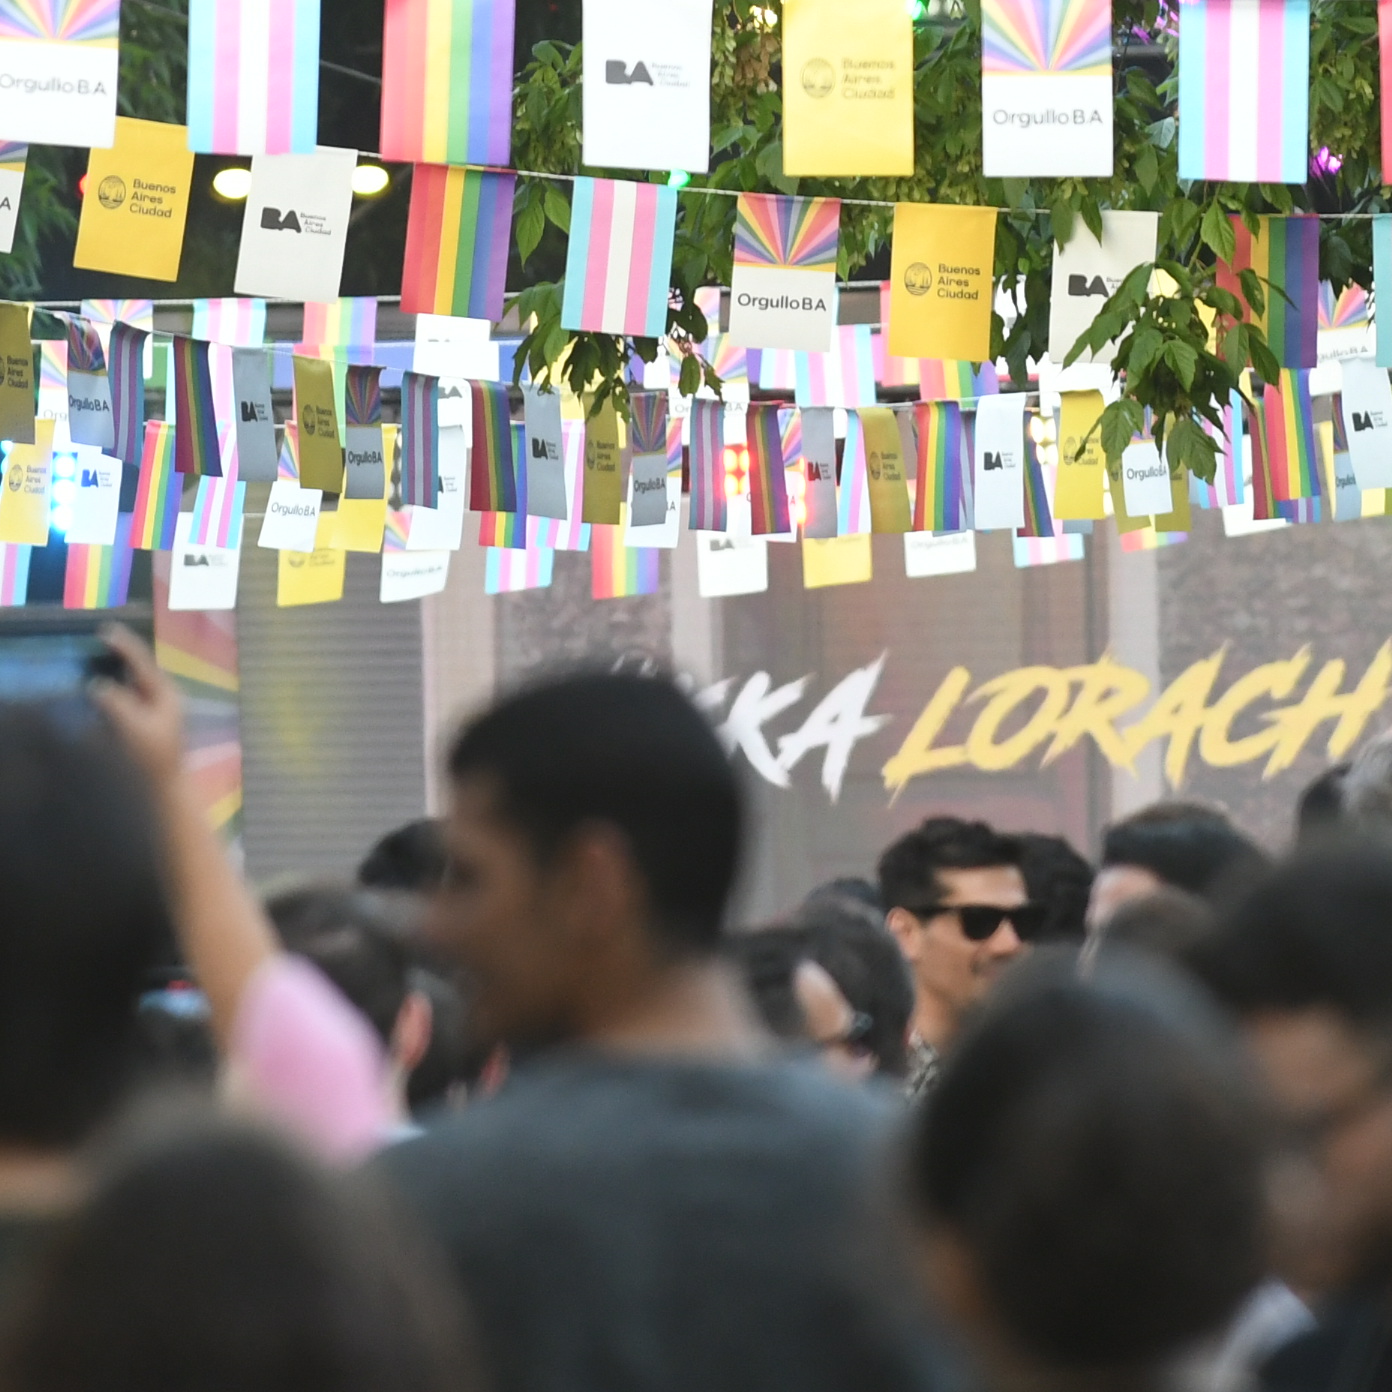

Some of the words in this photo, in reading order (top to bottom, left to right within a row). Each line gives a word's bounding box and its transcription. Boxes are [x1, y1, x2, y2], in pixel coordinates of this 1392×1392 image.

[841, 57, 895, 70] Buenos
[605, 59, 654, 87] BA
[842, 72, 882, 85] Aires
[841, 87, 895, 100] Ciudad
[992, 108, 1104, 128] OrgulloBA
[132, 178, 177, 194] Buenos
[131, 190, 164, 206] Aires
[128, 202, 173, 219] Ciudad
[260, 206, 302, 234] BA
[937, 263, 981, 276] Buenos
[937, 275, 969, 287] Aires
[1067, 273, 1109, 297] BA
[737, 292, 827, 313] OrgulloBA
[936, 287, 979, 301] Ciudad
[68, 393, 110, 412] OrgulloBA
[241, 401, 258, 422] BA
[1352, 412, 1374, 431] BA
[532, 438, 548, 460] BA
[347, 450, 382, 466] OrgulloBA
[983, 451, 1003, 471] BA
[81, 469, 99, 488] BA
[633, 478, 666, 494] OrgulloBA
[270, 502, 316, 517] OrgulloBA
